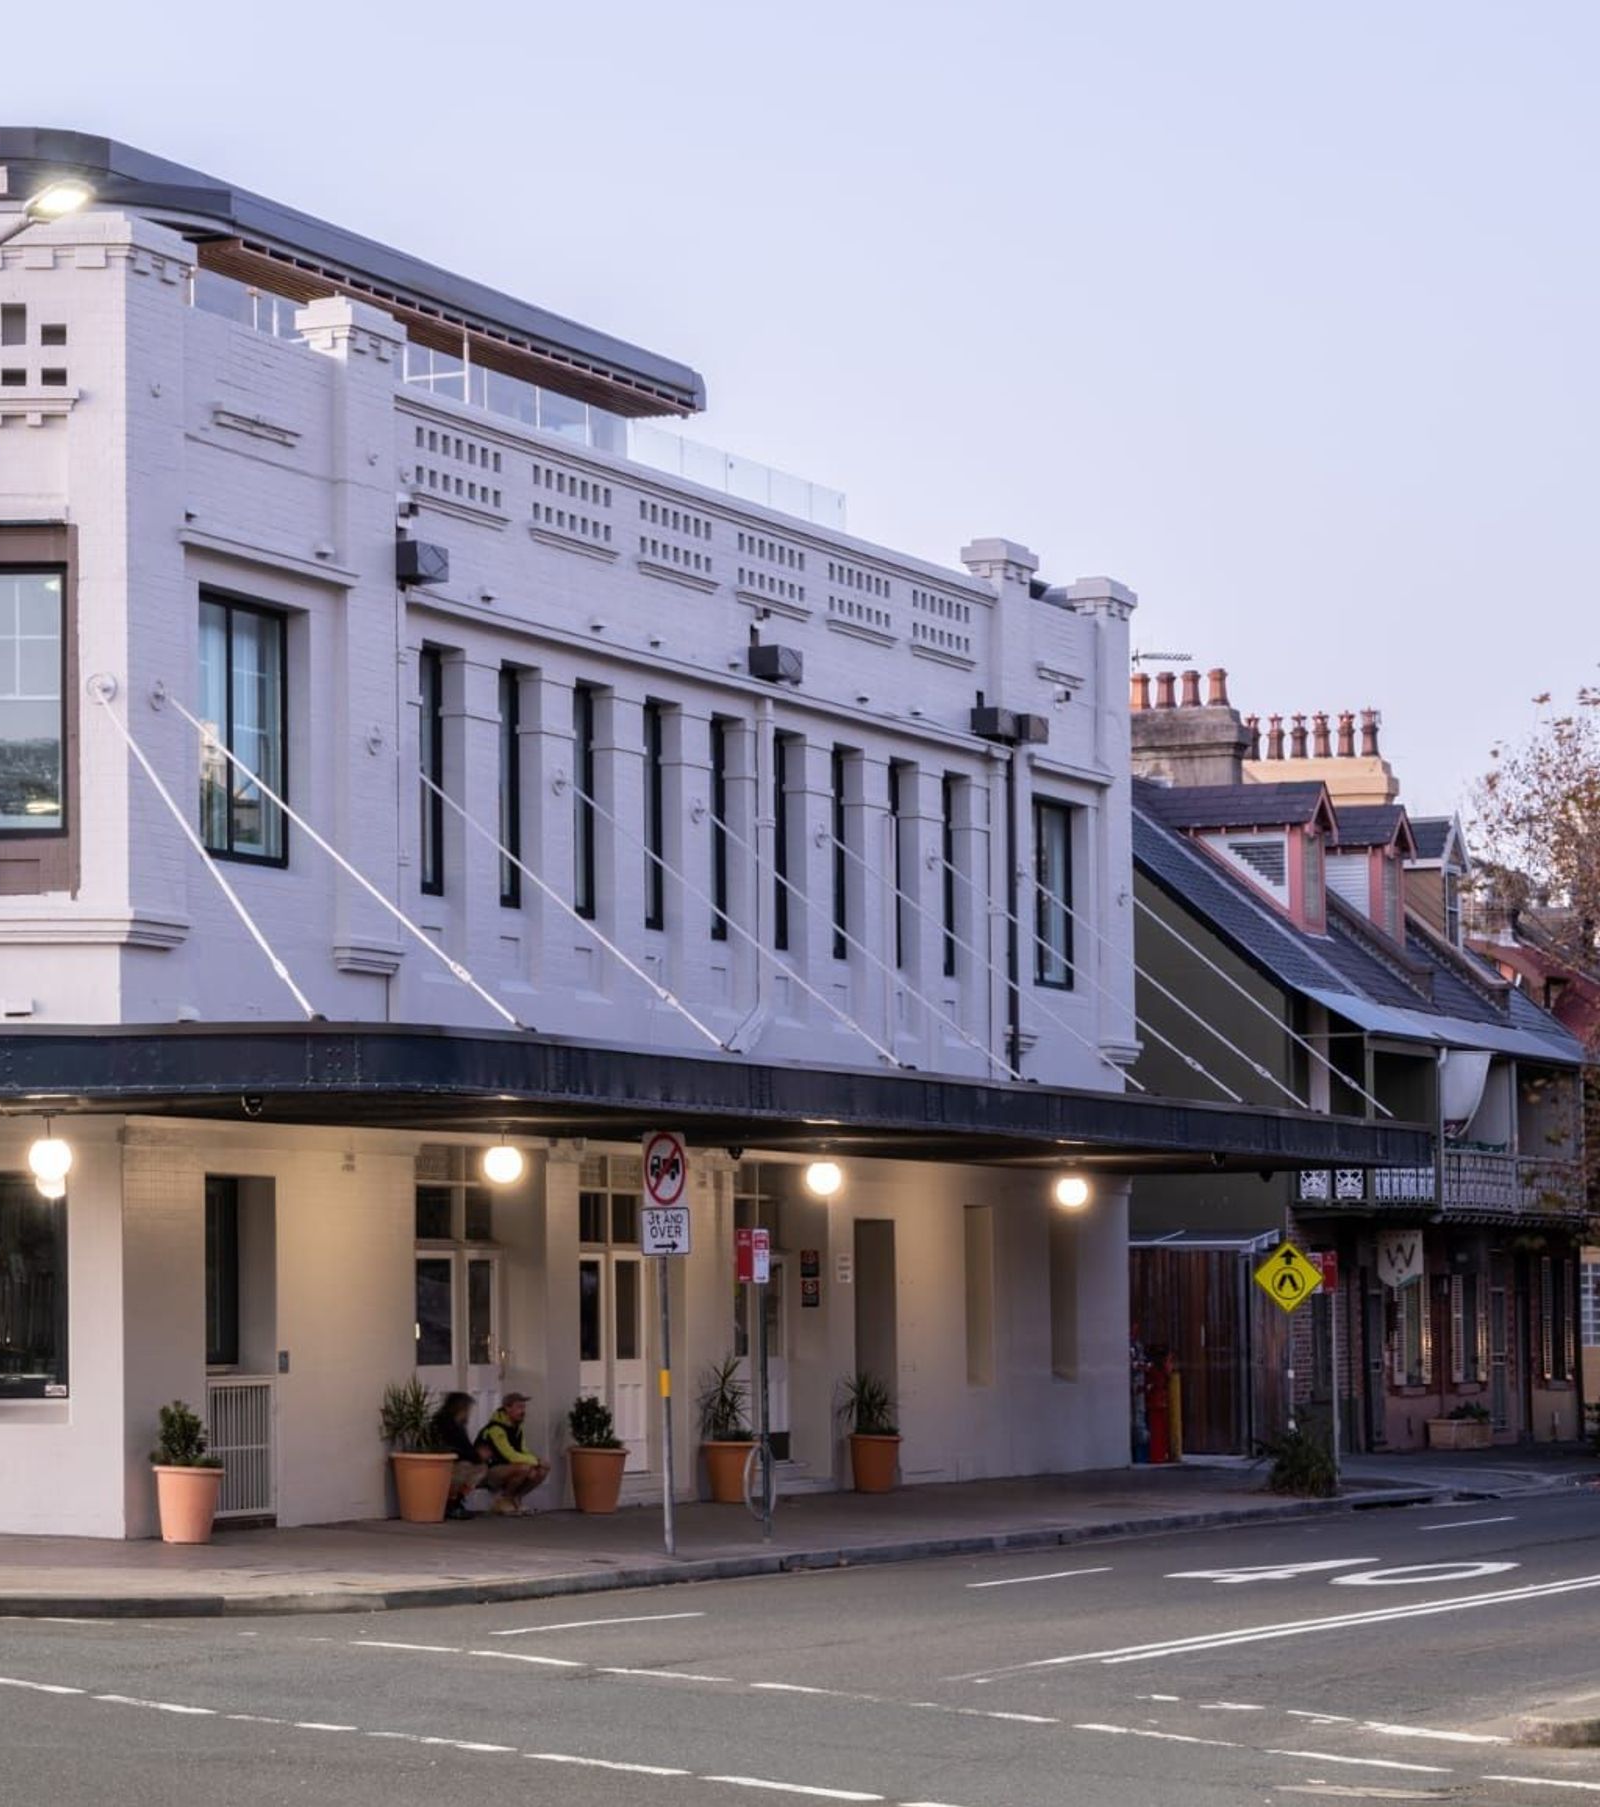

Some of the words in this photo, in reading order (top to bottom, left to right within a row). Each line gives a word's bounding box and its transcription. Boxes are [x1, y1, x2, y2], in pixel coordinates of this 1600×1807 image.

[663, 1212, 684, 1224] AND
[649, 1225, 682, 1239] OVER
[1384, 1243, 1416, 1268] W
[1163, 1557, 1521, 1585] 40
